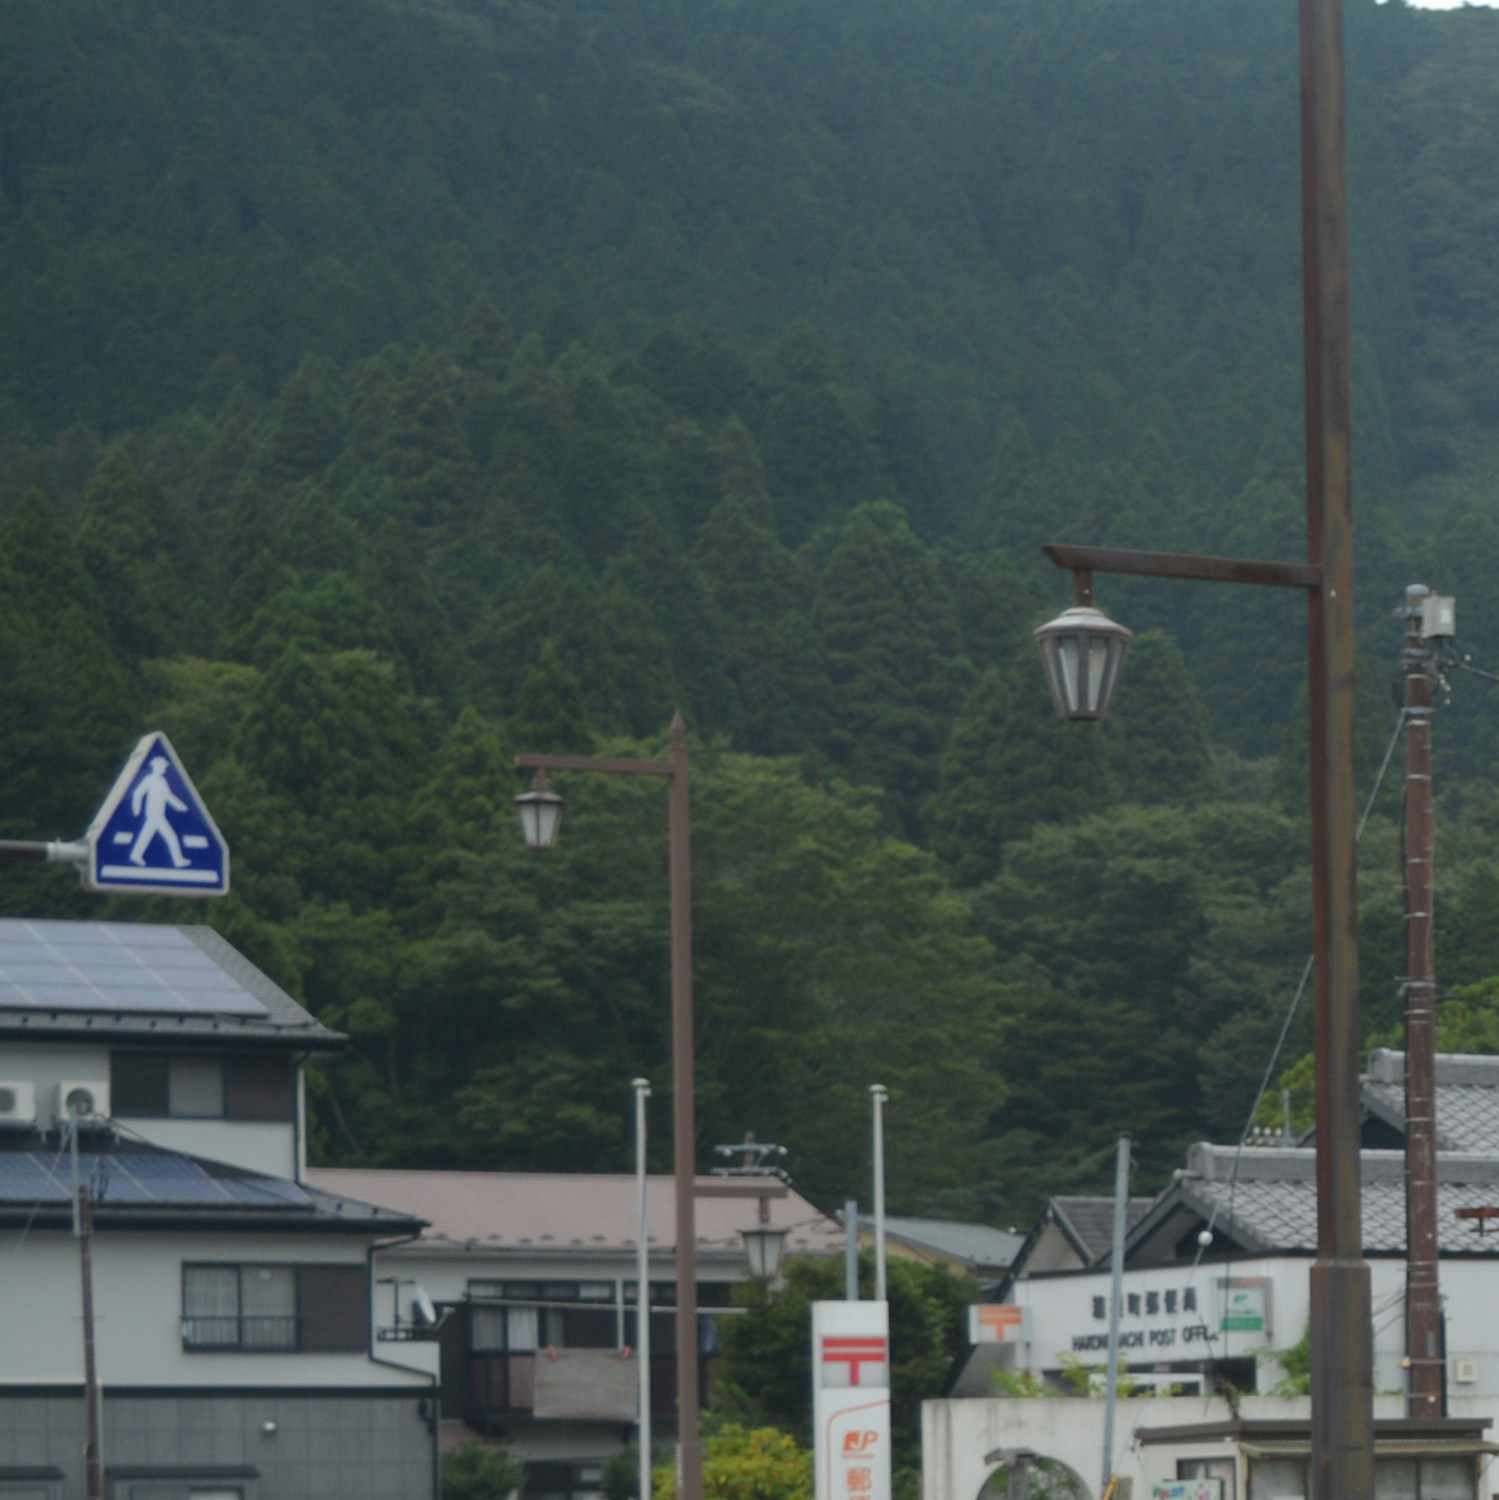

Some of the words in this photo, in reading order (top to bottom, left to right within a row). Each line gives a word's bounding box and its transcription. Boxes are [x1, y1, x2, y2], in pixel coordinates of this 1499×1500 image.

[1093, 1287, 1196, 1319] 箱町郵便局
[1150, 1329, 1176, 1346] POST
